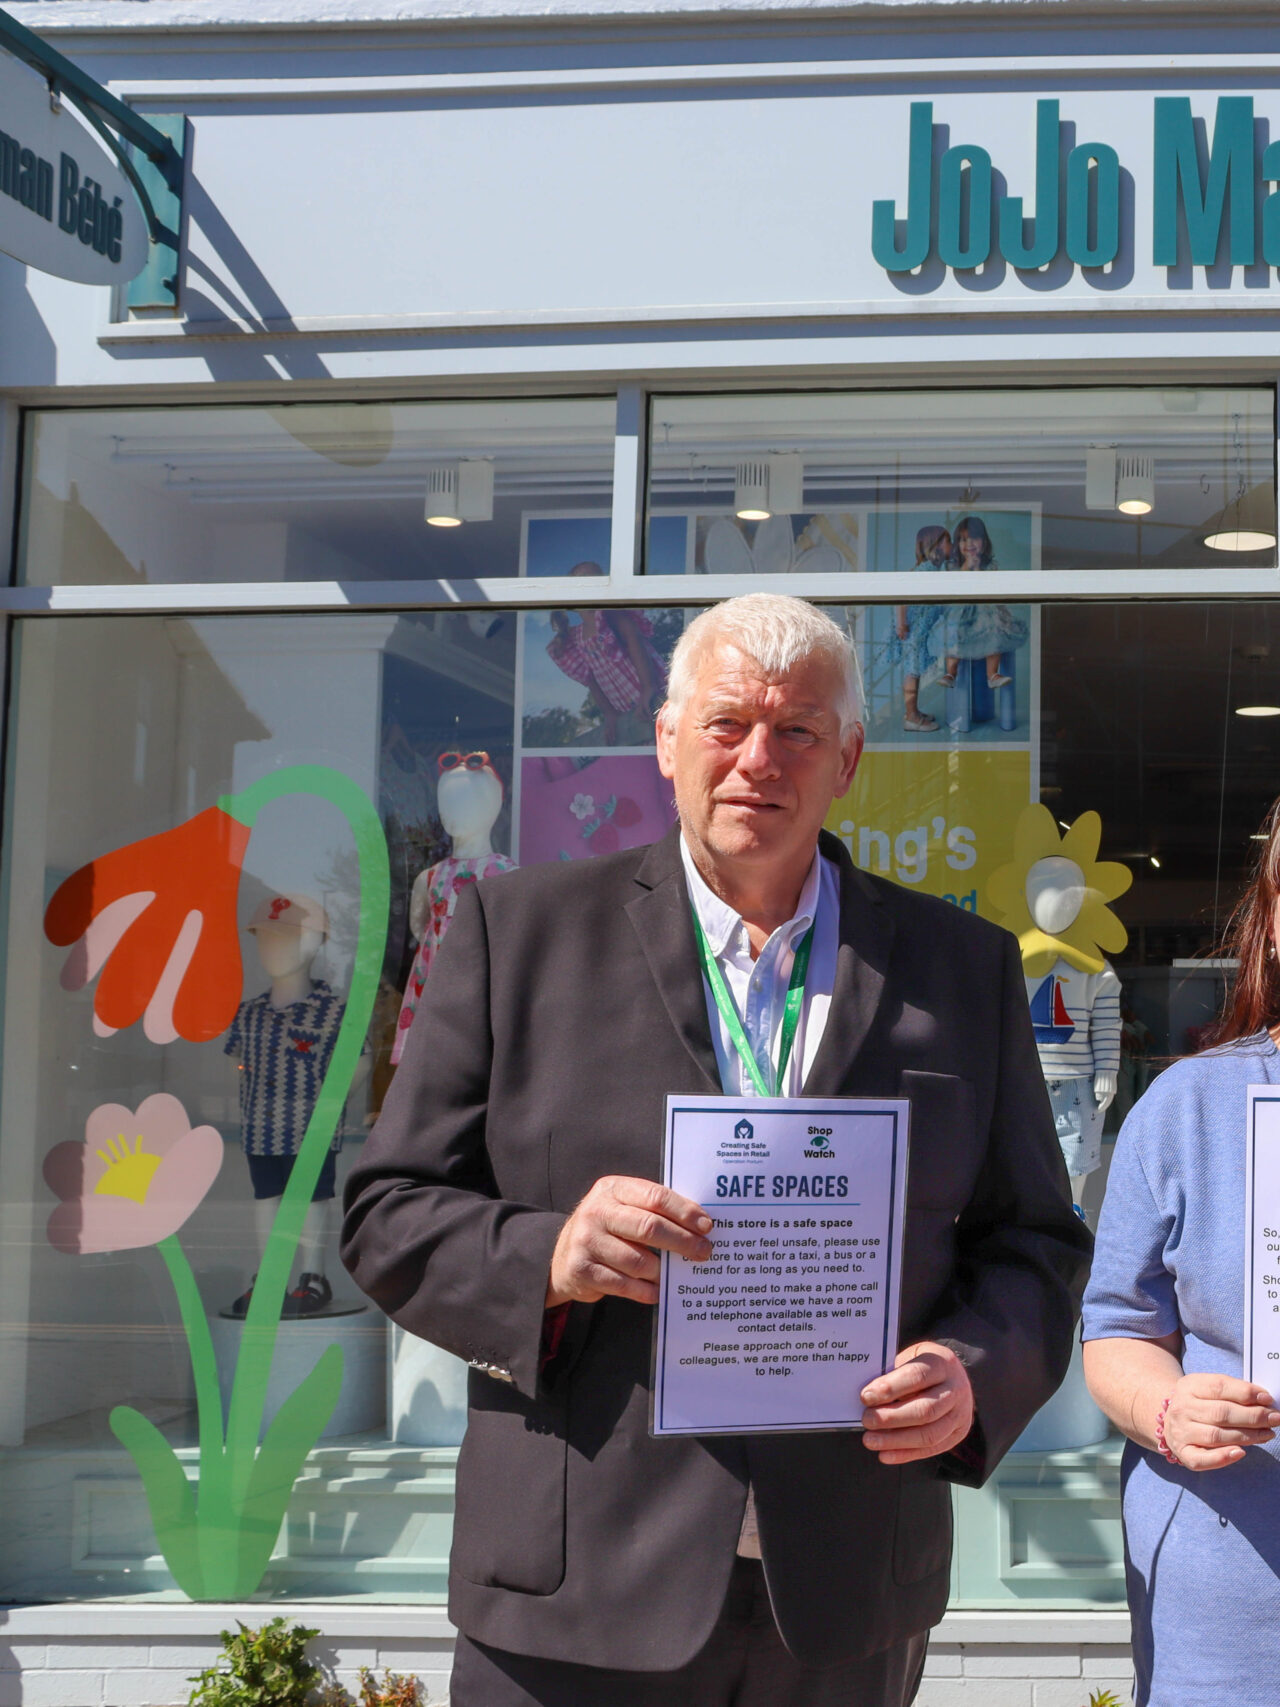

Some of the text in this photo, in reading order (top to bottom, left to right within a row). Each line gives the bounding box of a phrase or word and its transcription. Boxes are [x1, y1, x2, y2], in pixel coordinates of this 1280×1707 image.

[871, 99, 1119, 271] JoJo
[58, 151, 123, 263] Bébé
[807, 1126, 833, 1137] Shop
[720, 1142, 750, 1150] Creating
[716, 1150, 742, 1158] Spaces
[803, 1148, 835, 1159] Watch
[716, 1174, 848, 1198] SAFE SPACES
[709, 1218, 853, 1230] This store is a safe space
[1263, 1227, 1280, 1239] So,
[1267, 1289, 1278, 1299] to
[686, 1308, 867, 1322] and telephone available as well as
[737, 1322, 816, 1333] contact details.
[703, 1339, 848, 1353] Please approach one of our
[755, 1366, 794, 1377] to help.
